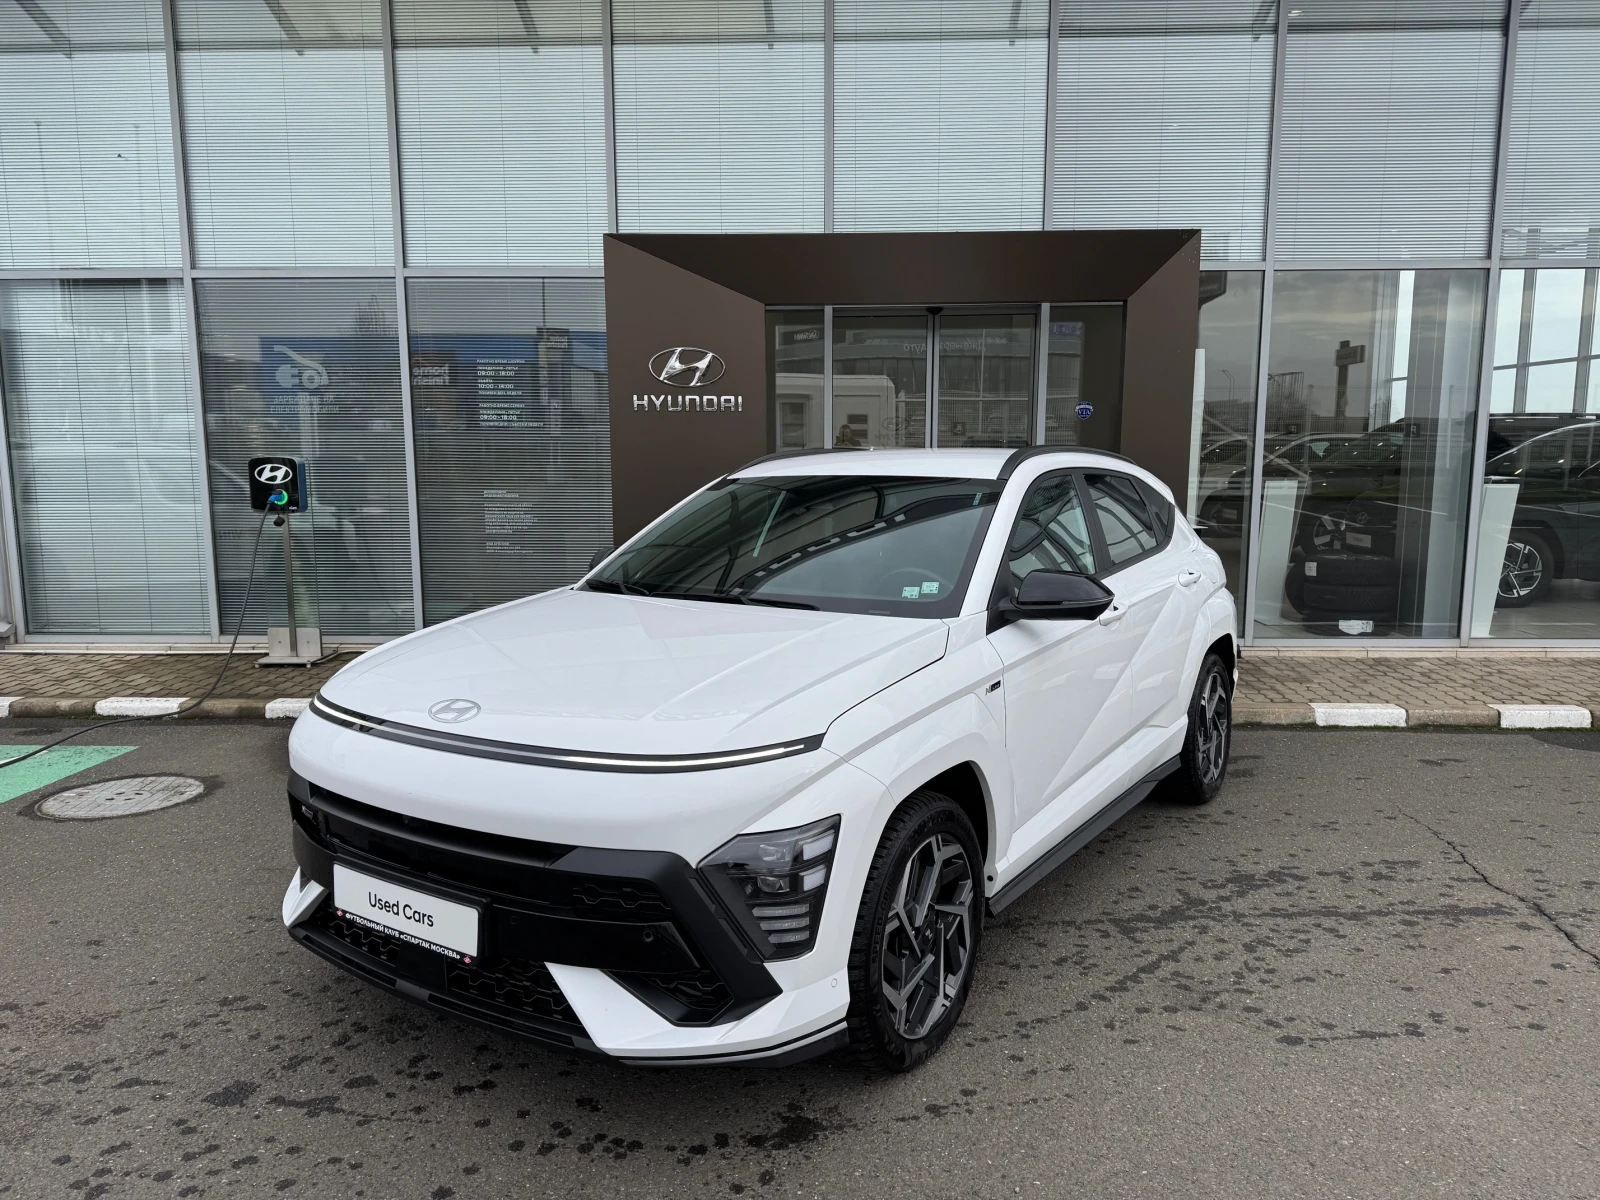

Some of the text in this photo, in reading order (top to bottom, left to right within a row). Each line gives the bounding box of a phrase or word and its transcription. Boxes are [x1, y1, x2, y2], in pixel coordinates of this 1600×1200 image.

[633, 394, 743, 412] HYUNDAI
[368, 891, 434, 927] Used Cars
[345, 913, 461, 960] ФУТБОЛЬНЫЙ КЛУБ «СПАРТАК МОСКВА»
